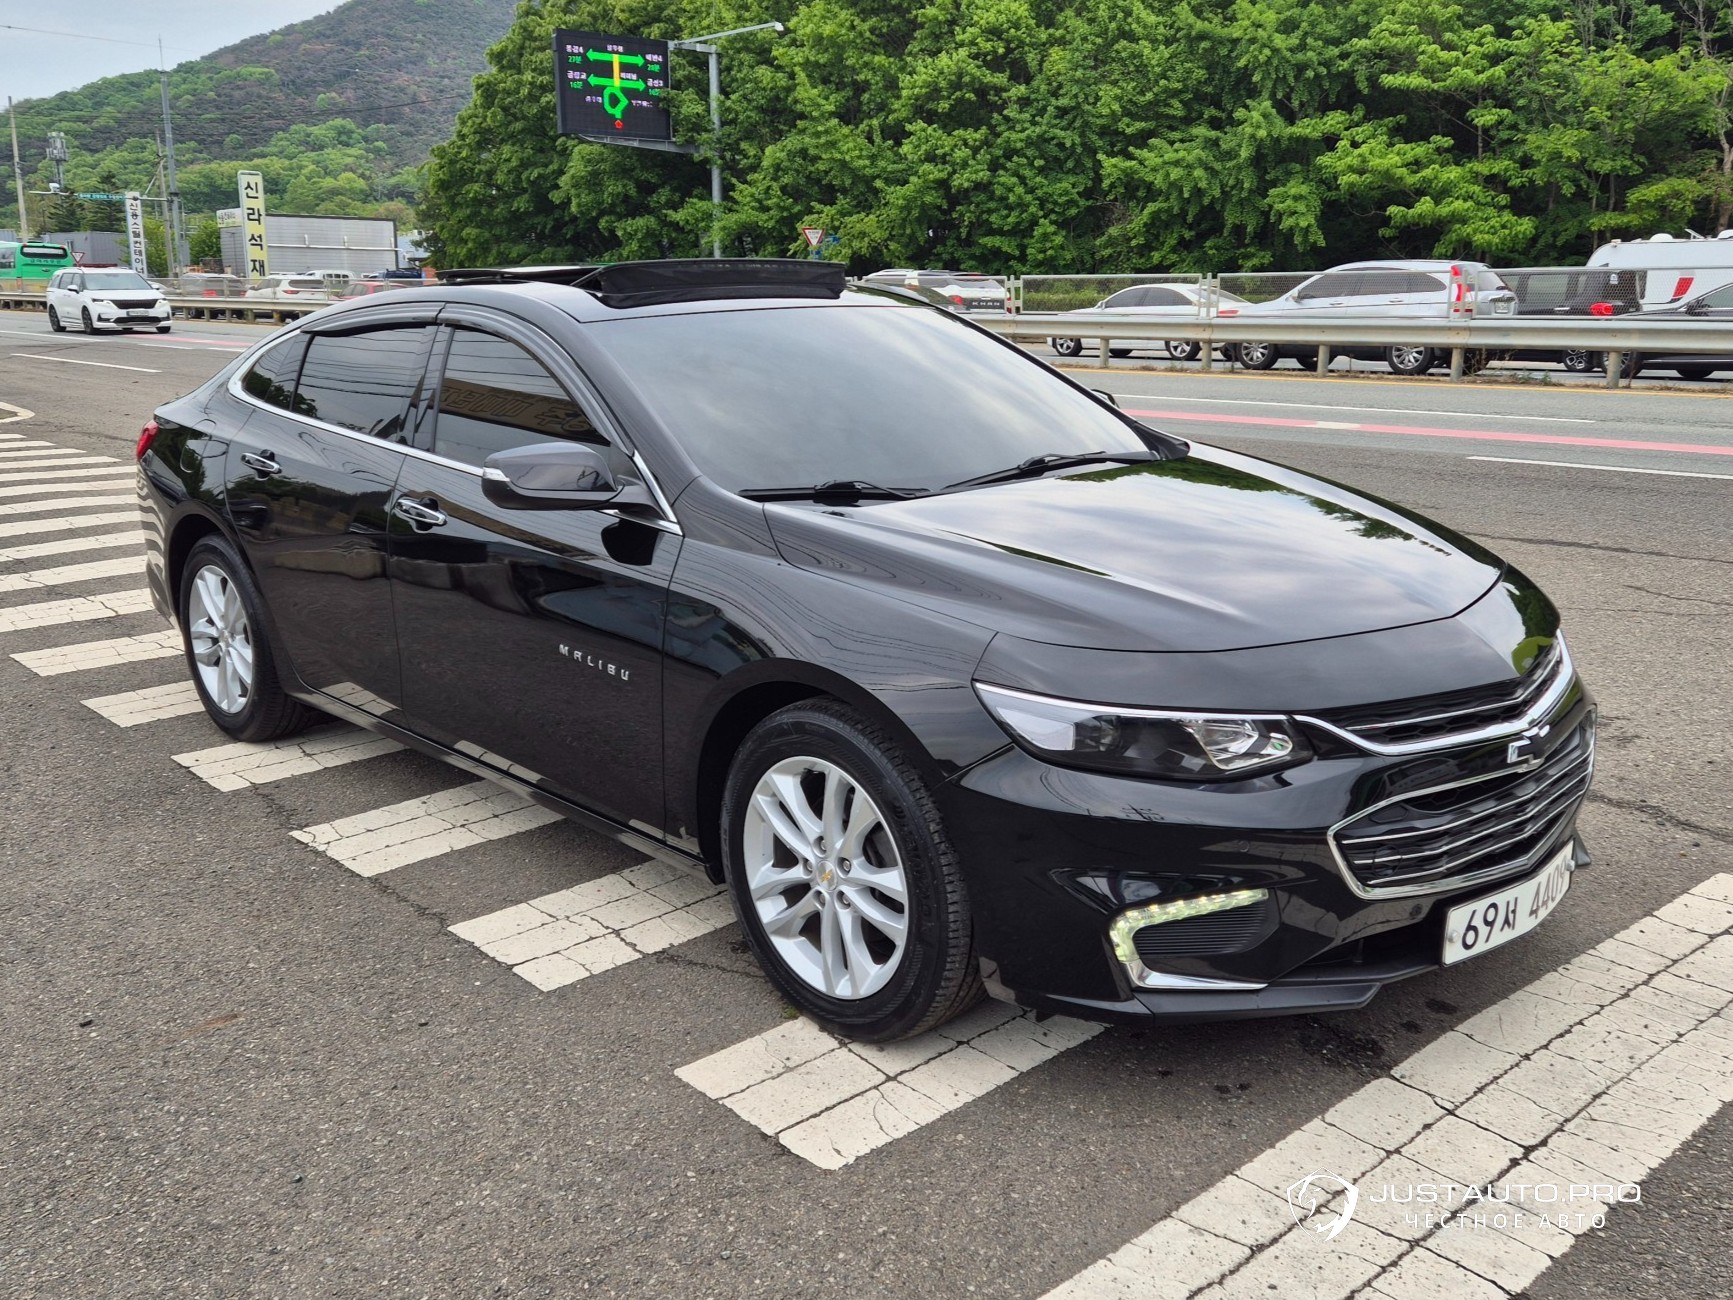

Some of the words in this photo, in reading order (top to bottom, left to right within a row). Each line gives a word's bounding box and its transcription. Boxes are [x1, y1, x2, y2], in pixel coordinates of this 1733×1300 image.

[244, 181, 266, 277] 신라석재
[559, 644, 629, 681] MALIBU
[1462, 896, 1518, 951] 69서
[1529, 854, 1568, 920] 4409
